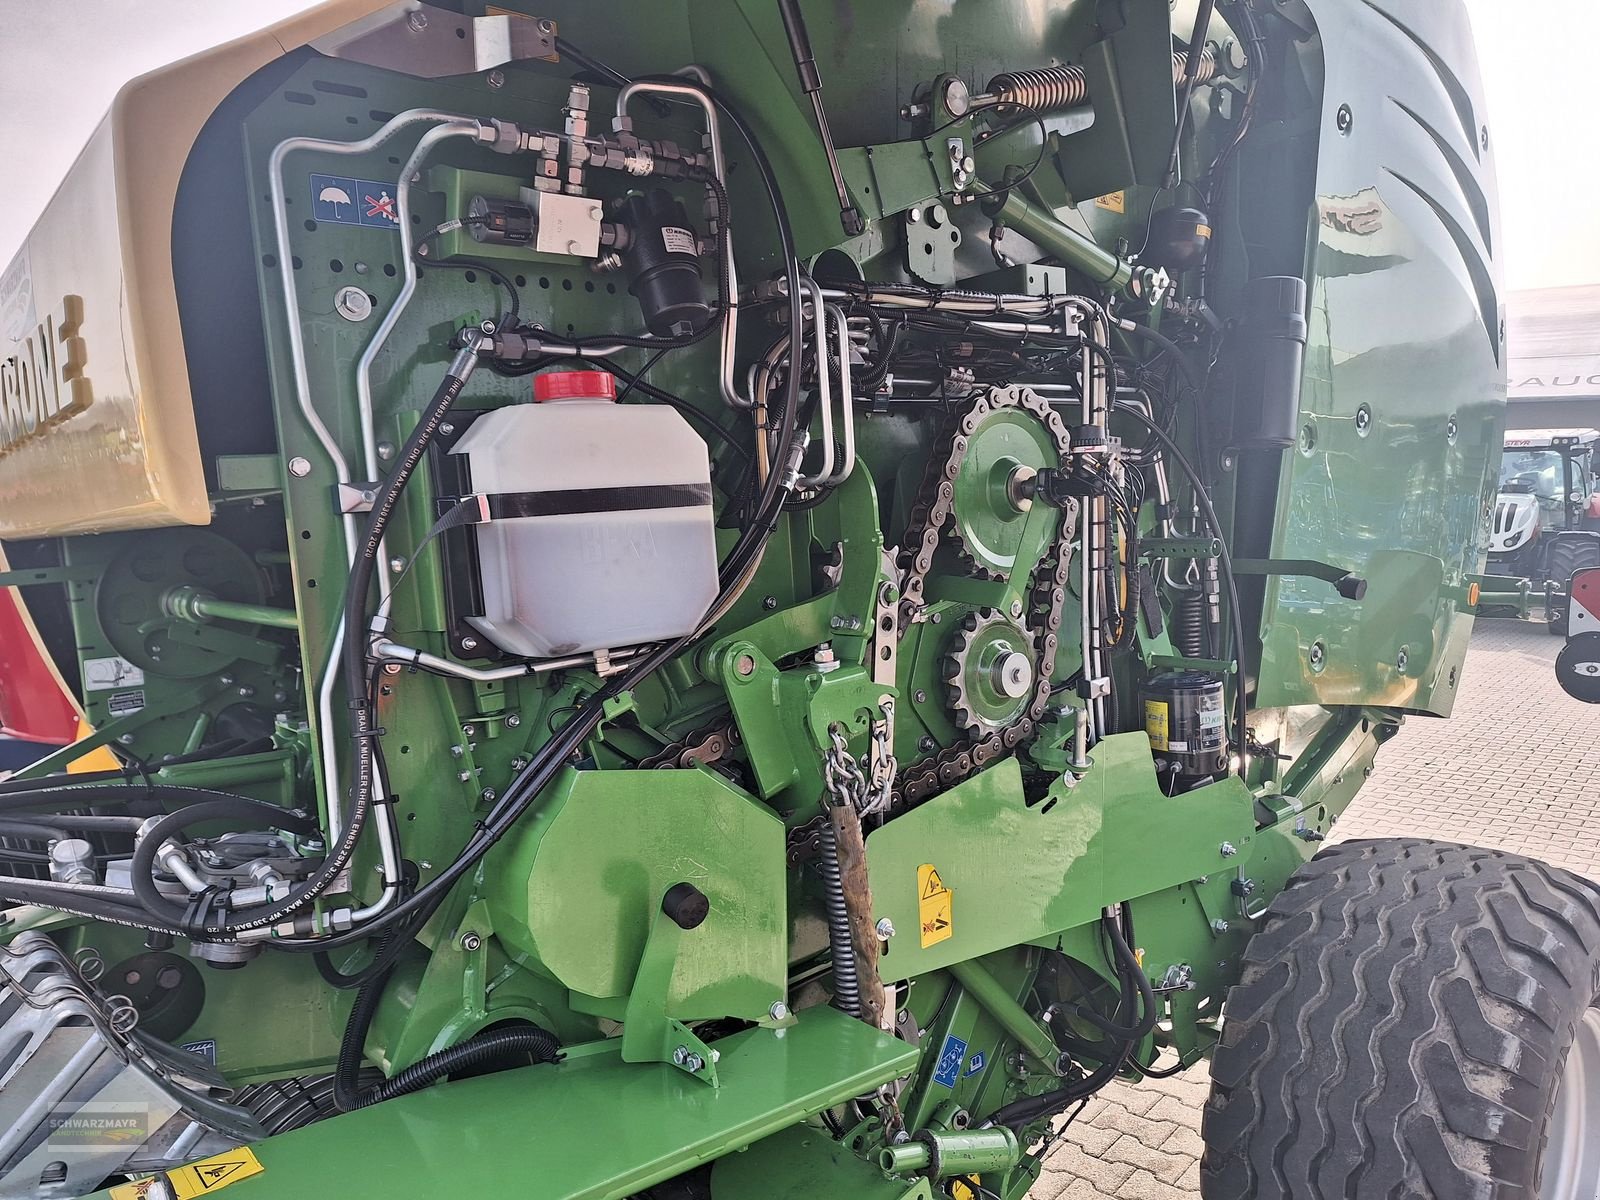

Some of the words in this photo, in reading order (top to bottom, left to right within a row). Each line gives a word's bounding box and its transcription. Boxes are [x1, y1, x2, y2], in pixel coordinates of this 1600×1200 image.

[1507, 374, 1600, 388] AUC
[434, 395, 451, 418] EN853
[425, 417, 438, 434] 2SN
[405, 448, 420, 469] DN10
[387, 490, 398, 504] WP
[380, 503, 391, 517] 330
[372, 517, 386, 534] BAR
[360, 746, 369, 787] MUELLER
[354, 788, 367, 821] RHEINE
[343, 823, 360, 850] EN853
[334, 850, 348, 867] 2SN
[303, 881, 325, 900] DN10
[252, 917, 269, 927] 330
[269, 912, 283, 922] WP
[233, 922, 253, 932] BAR
